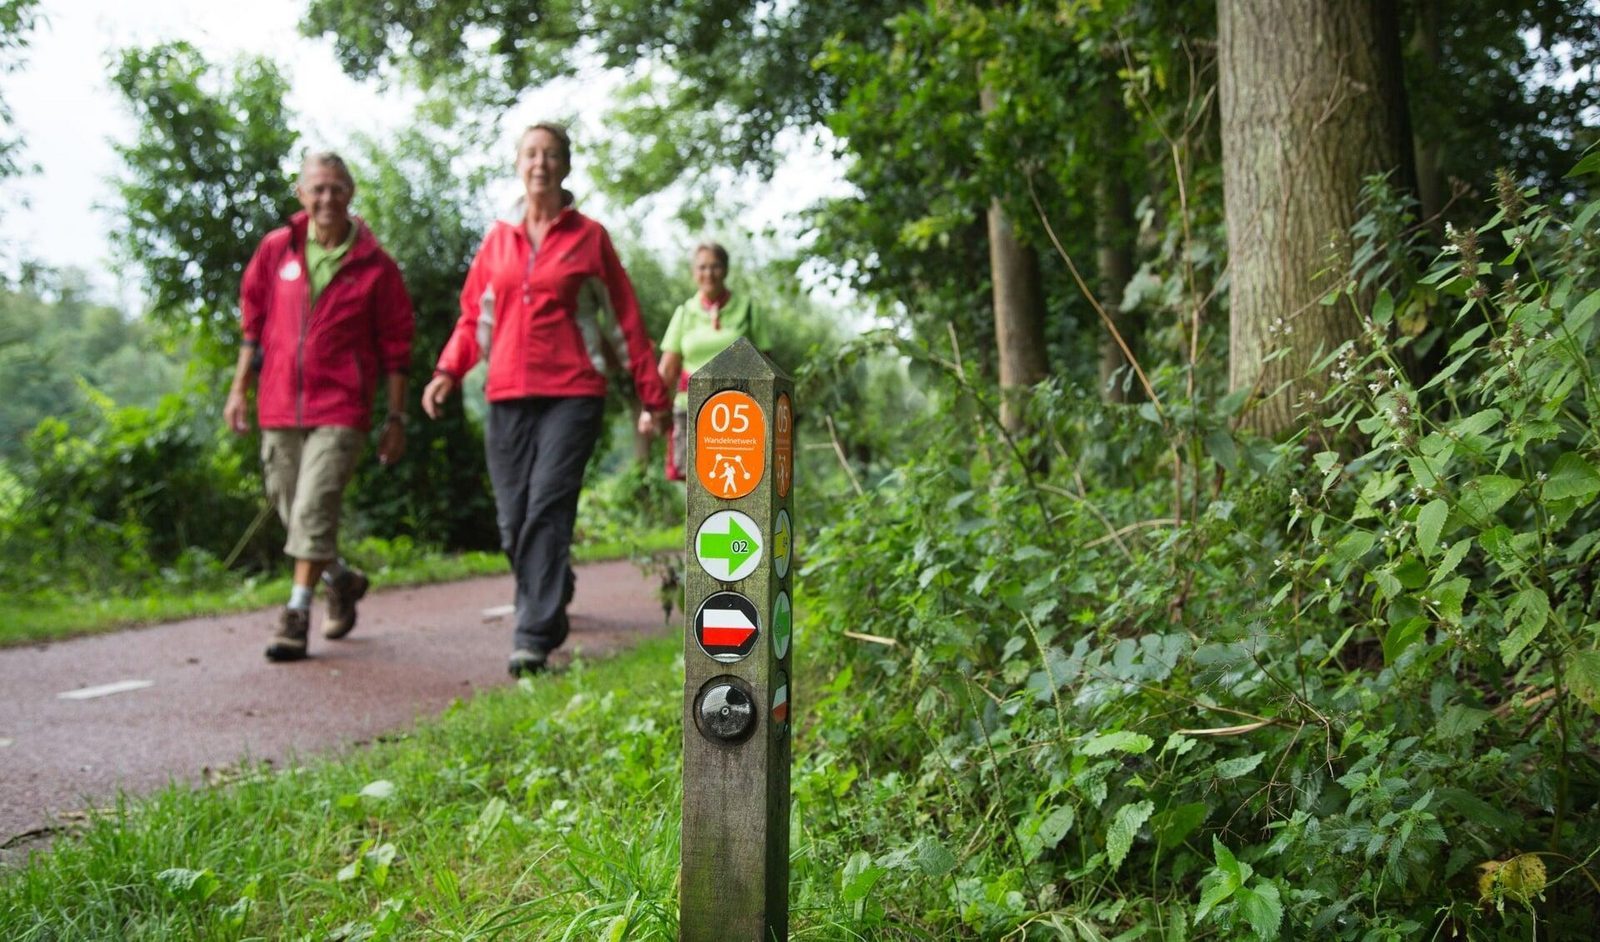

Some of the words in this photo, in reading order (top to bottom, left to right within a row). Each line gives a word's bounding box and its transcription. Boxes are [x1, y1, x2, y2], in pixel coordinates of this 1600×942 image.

[711, 403, 749, 433] 05
[778, 405, 788, 433] 05
[704, 436, 757, 445] Wandelnetwerk
[732, 541, 748, 553] 02
